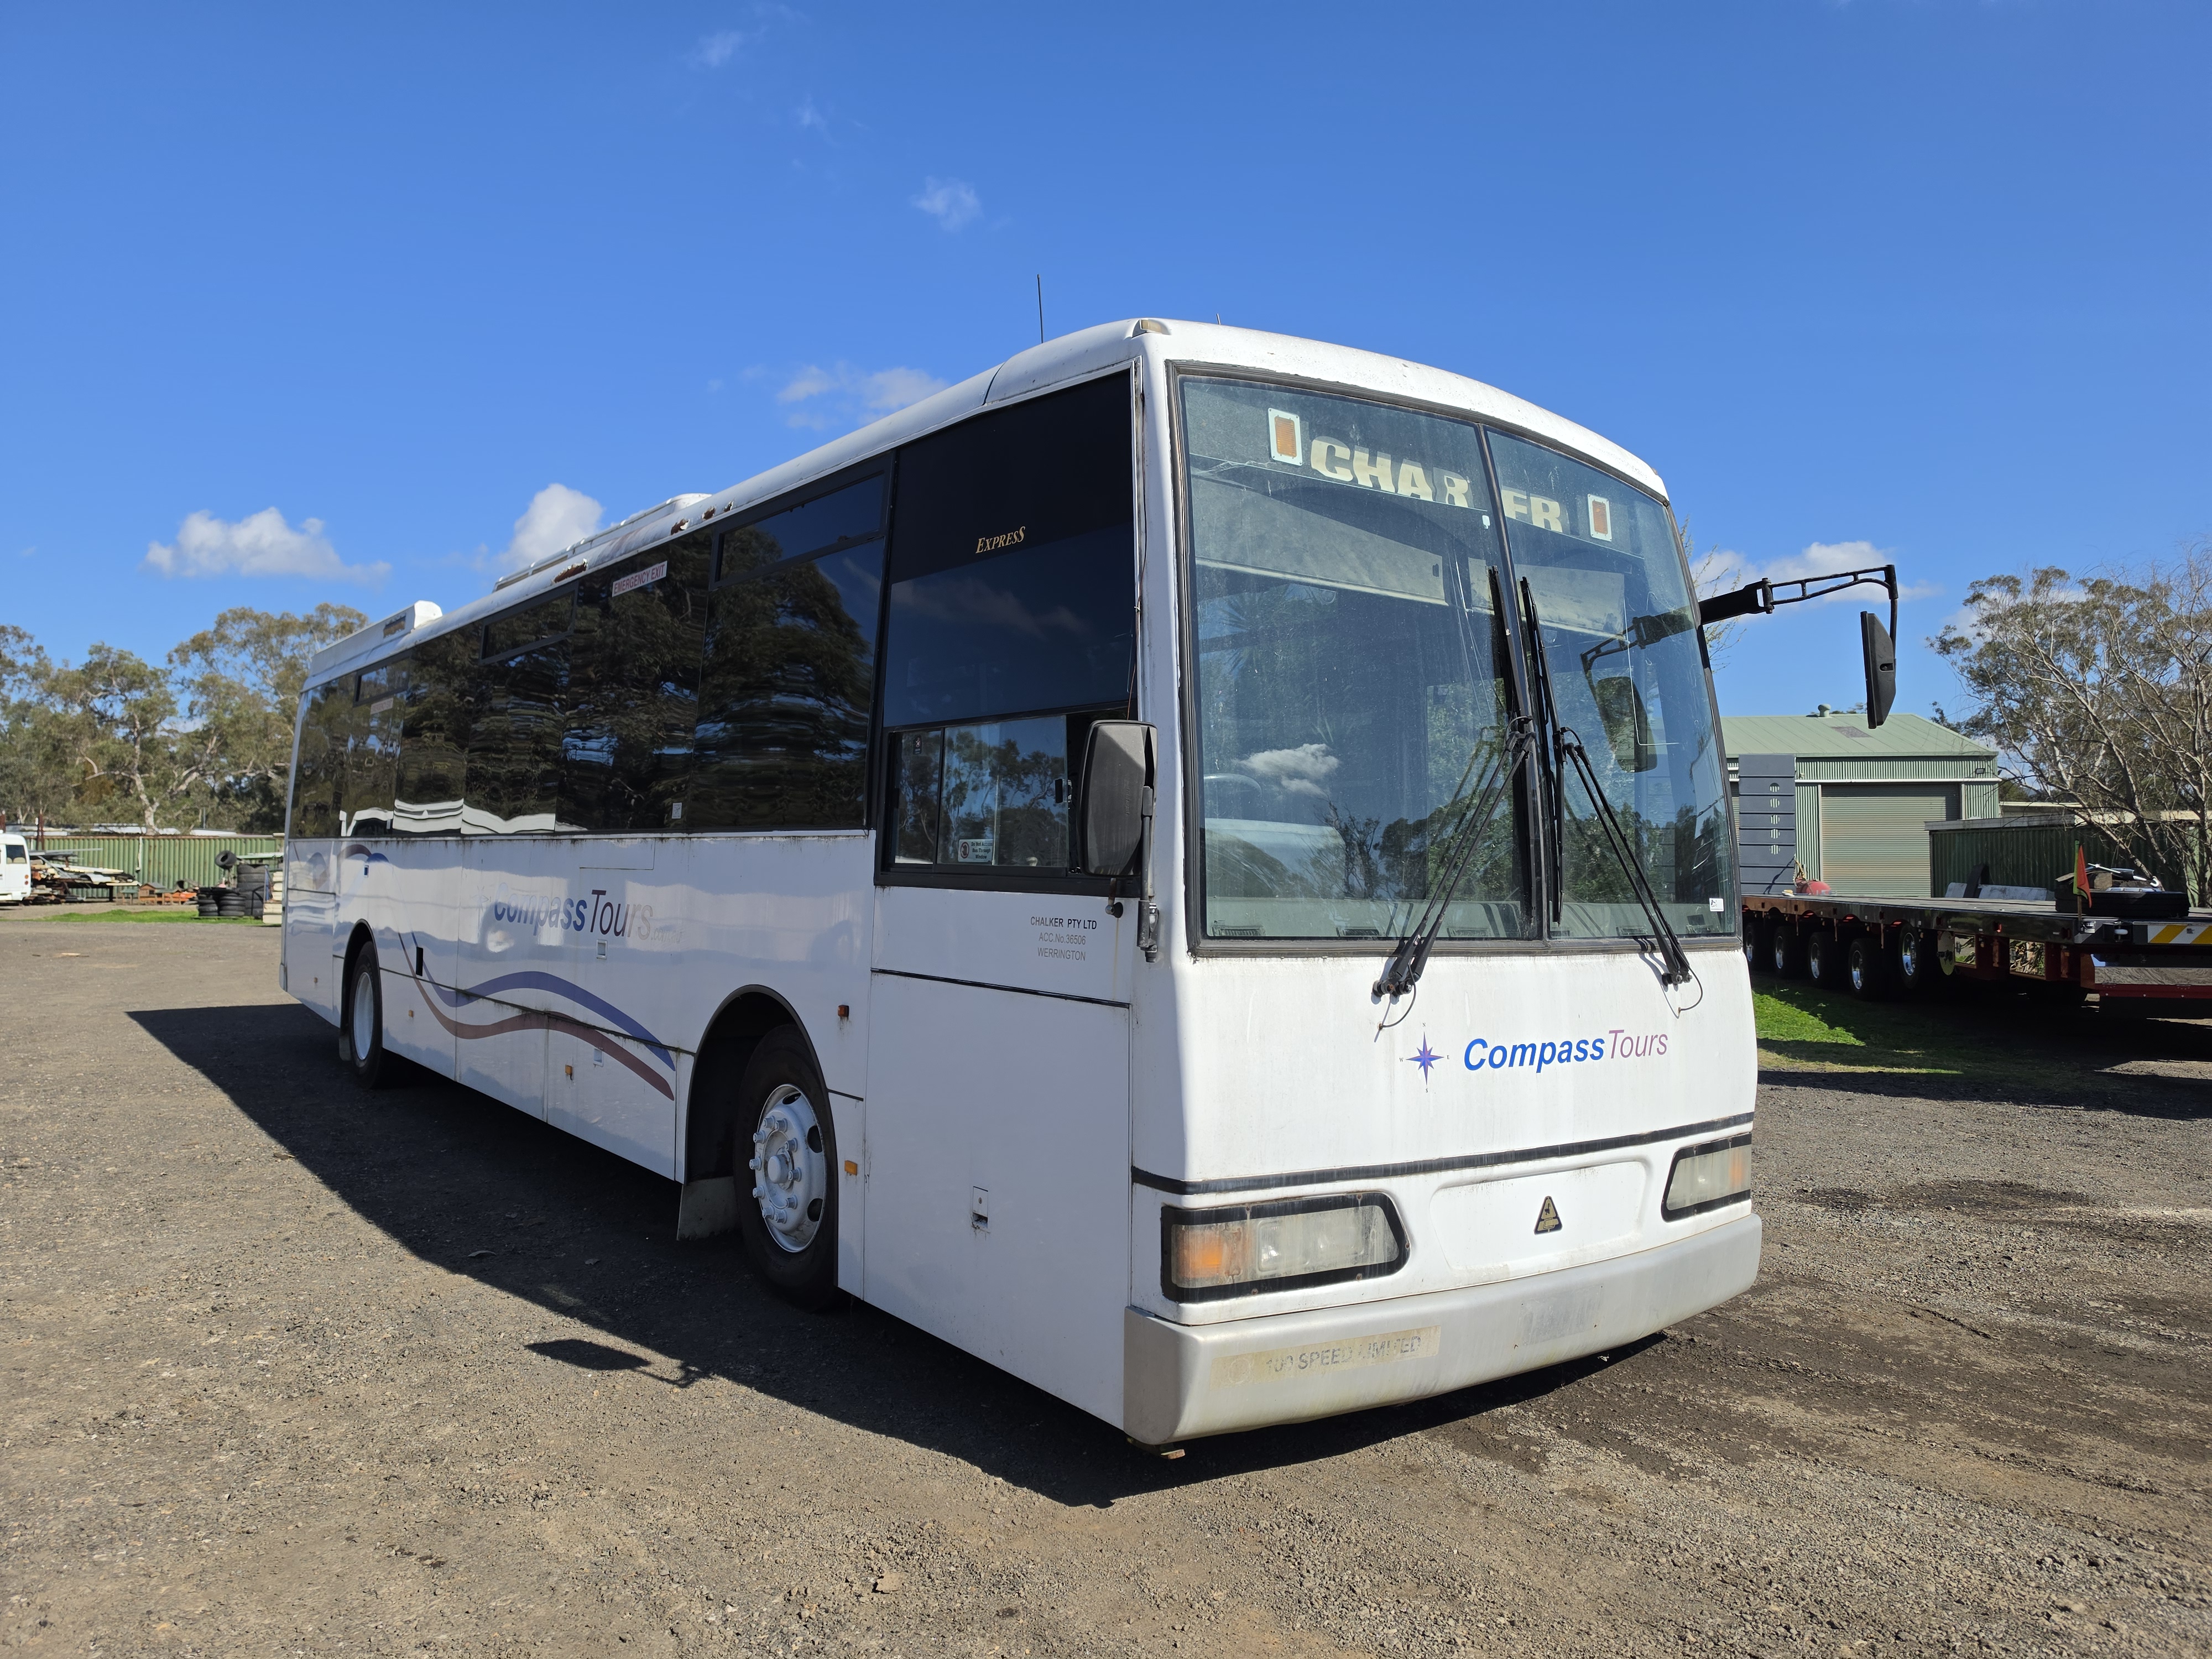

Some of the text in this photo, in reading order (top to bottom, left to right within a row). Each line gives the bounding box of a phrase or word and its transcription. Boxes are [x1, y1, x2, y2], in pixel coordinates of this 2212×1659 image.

[1310, 436, 1563, 533] CHARER
[975, 526, 1026, 554] EXPRESS
[614, 564, 665, 594] EMERGENCY EXIT
[1030, 916, 1097, 930] CHALKER PTY LTD
[1037, 947, 1086, 961] WERRINGTON
[1298, 1347, 1353, 1370] SPEED
[1358, 1335, 1421, 1359] IMIED
